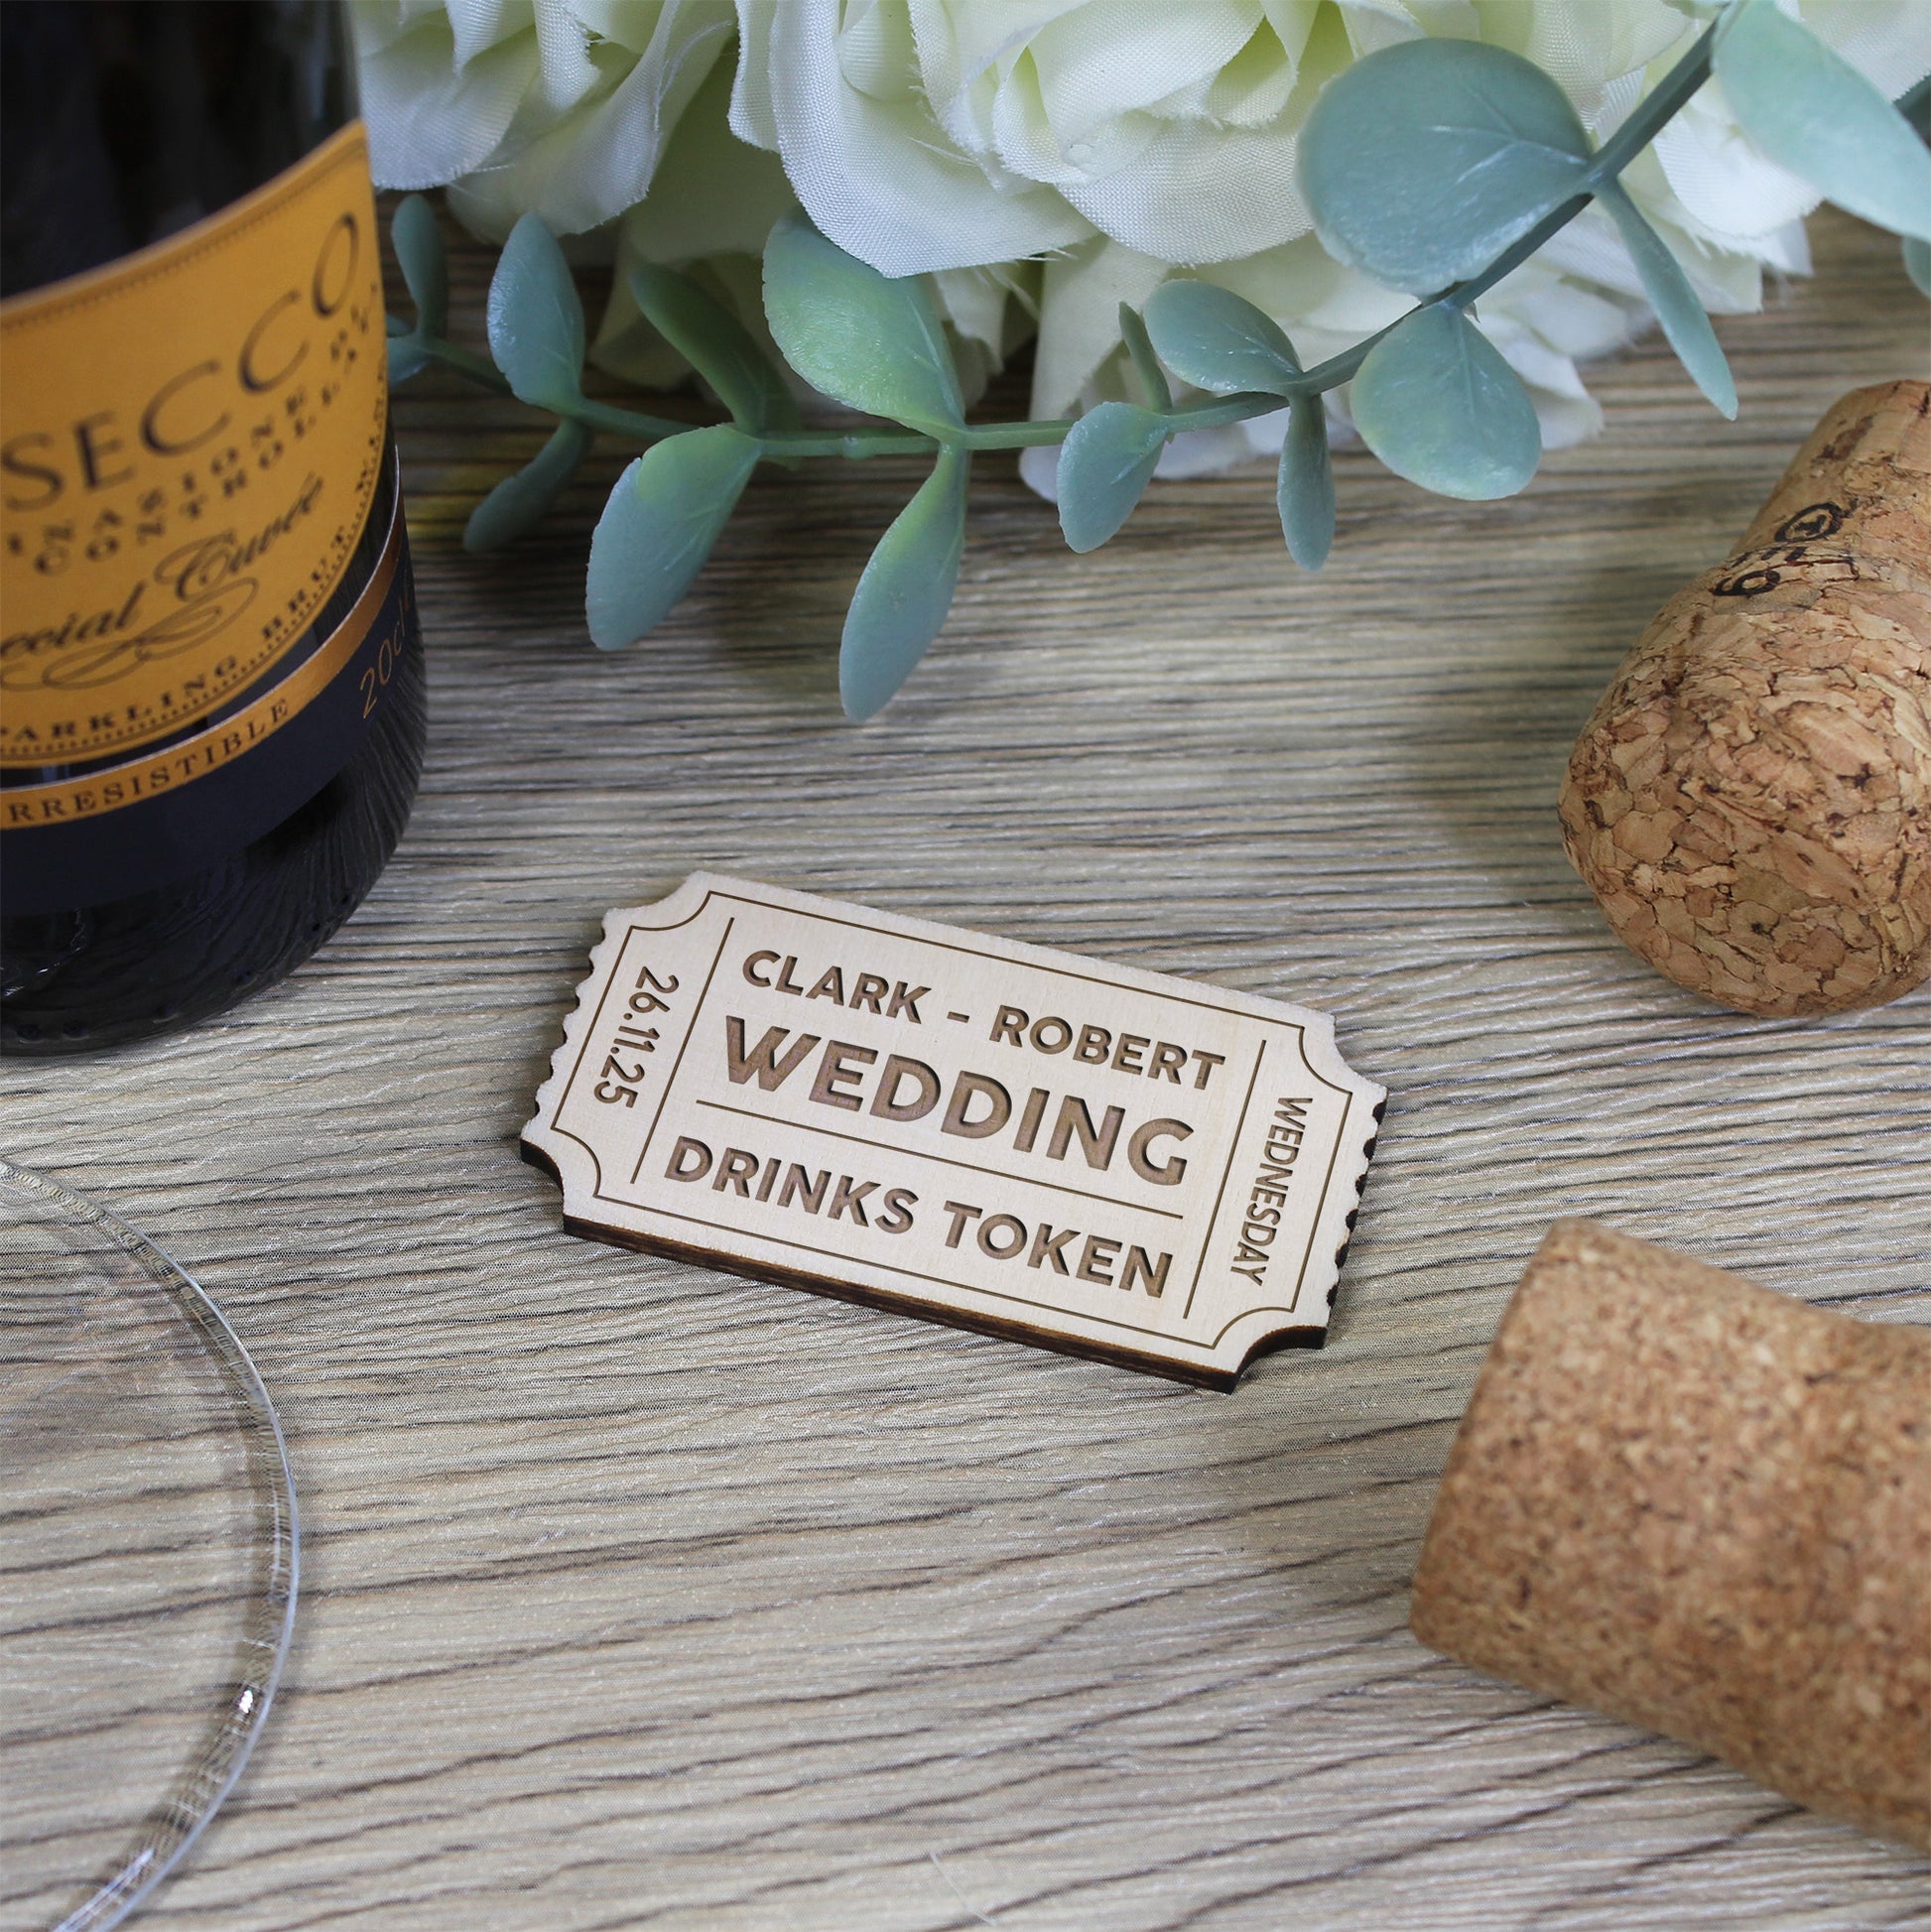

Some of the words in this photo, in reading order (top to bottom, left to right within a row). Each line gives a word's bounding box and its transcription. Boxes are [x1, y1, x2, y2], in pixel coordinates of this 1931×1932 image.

[0, 655, 237, 742] ARKLING
[592, 965, 680, 1109] 26.11.25
[741, 949, 932, 1025] CLARK
[988, 1003, 1226, 1092] ROBERT
[724, 1014, 1195, 1187] WEDDING
[663, 1135, 921, 1235] DRINKS
[942, 1199, 1174, 1300] TOKEN
[1229, 1095, 1314, 1287] WEDNESDAY
